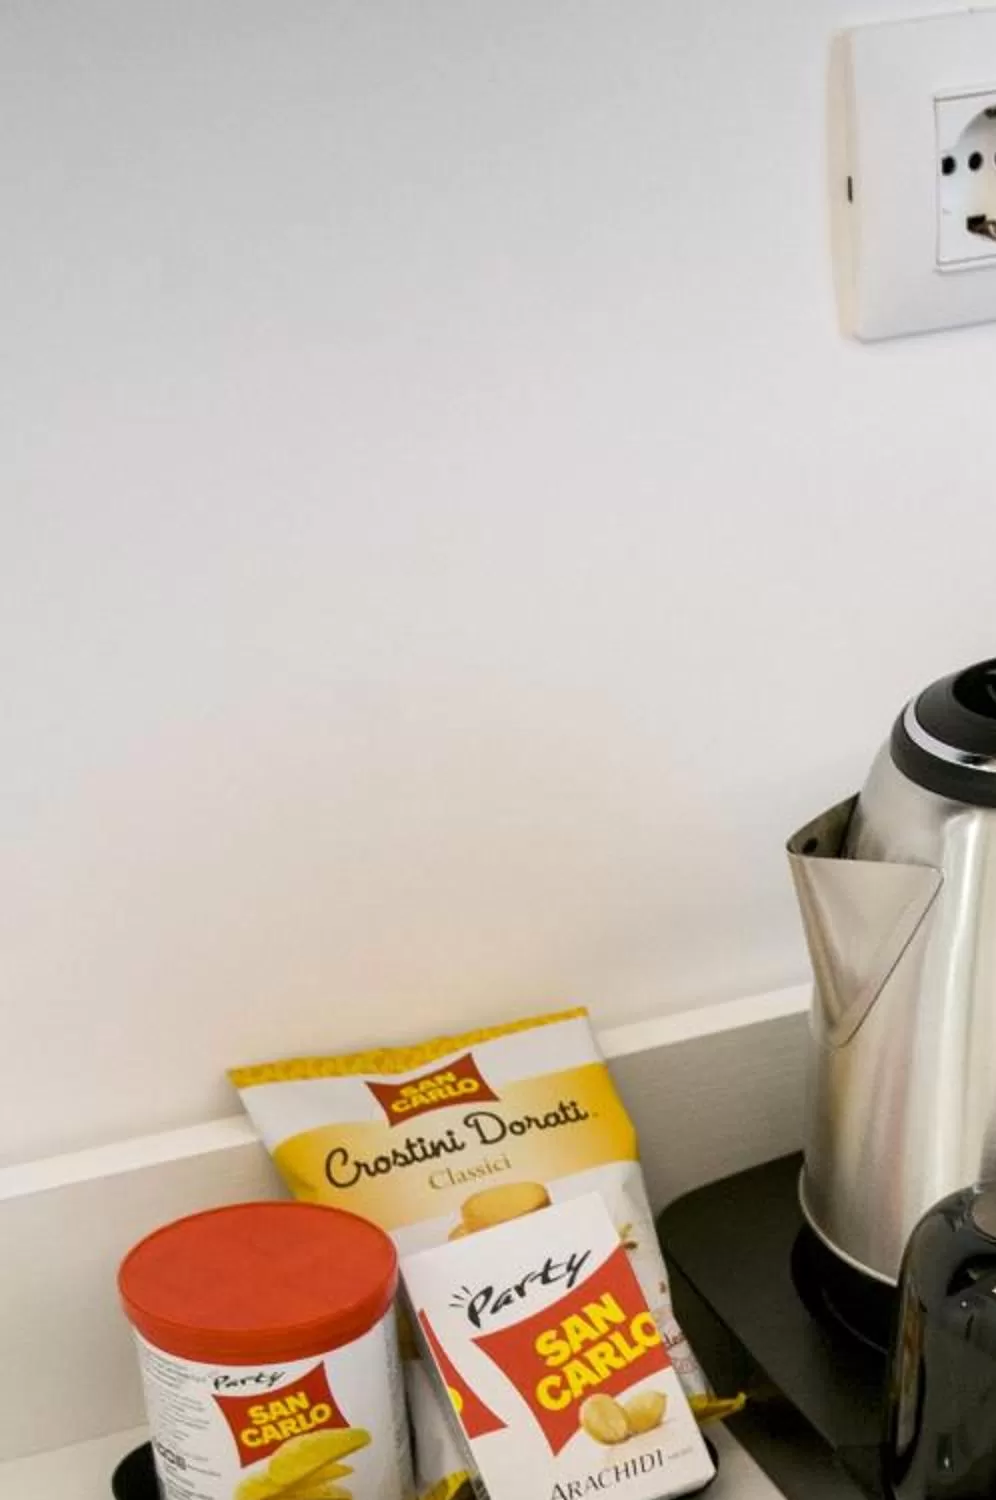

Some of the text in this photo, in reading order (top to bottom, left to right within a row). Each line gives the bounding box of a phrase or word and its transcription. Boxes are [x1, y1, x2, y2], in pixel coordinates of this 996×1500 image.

[391, 1077, 480, 1113] CARLO
[401, 1071, 457, 1097] SAN
[325, 1100, 589, 1188] Crostini Dorati
[428, 1154, 512, 1190] Classici
[466, 1249, 591, 1328] Party
[535, 1292, 626, 1366] SAN
[213, 1371, 286, 1390] Party
[535, 1311, 663, 1411] CARLO
[240, 1403, 332, 1448] CARLO
[248, 1392, 311, 1426] SAN
